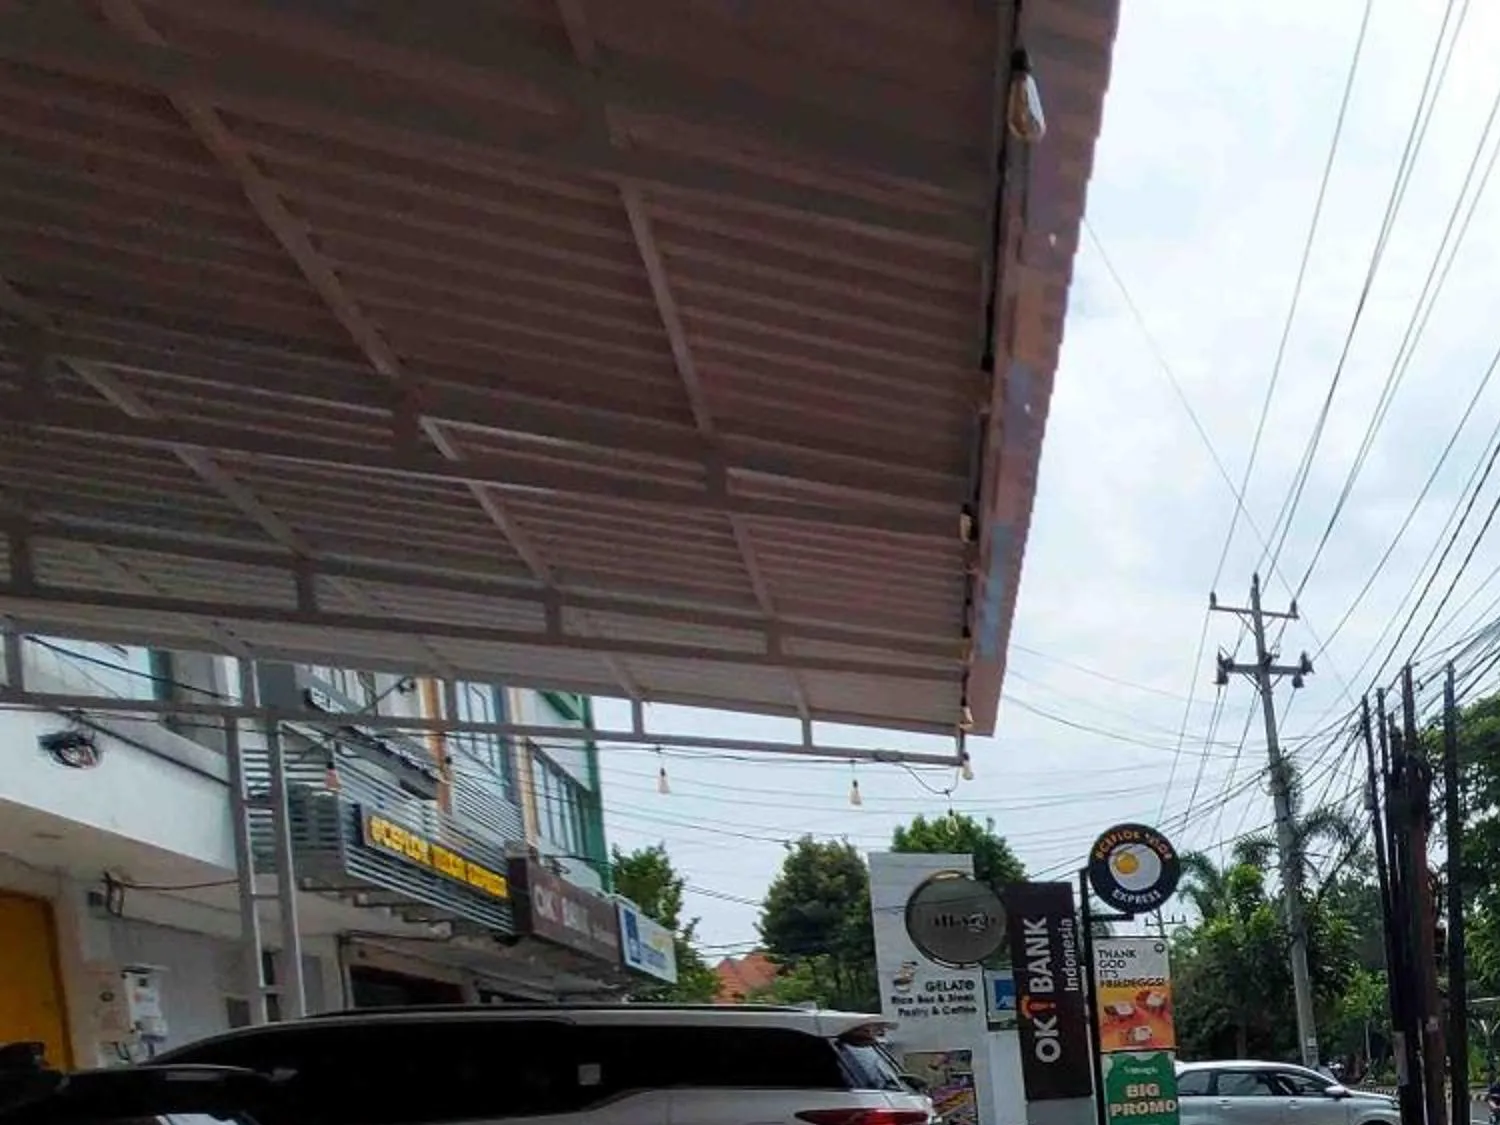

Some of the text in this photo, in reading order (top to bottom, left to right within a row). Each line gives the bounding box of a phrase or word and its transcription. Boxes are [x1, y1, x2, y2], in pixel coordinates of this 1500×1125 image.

[1023, 917, 1055, 993] BANK
[1058, 917, 1079, 991] Indonesia
[1098, 949, 1137, 959] THANK
[925, 980, 975, 992] GELATO
[1126, 1083, 1160, 1098] BIG
[1110, 1099, 1177, 1117] PROMO
